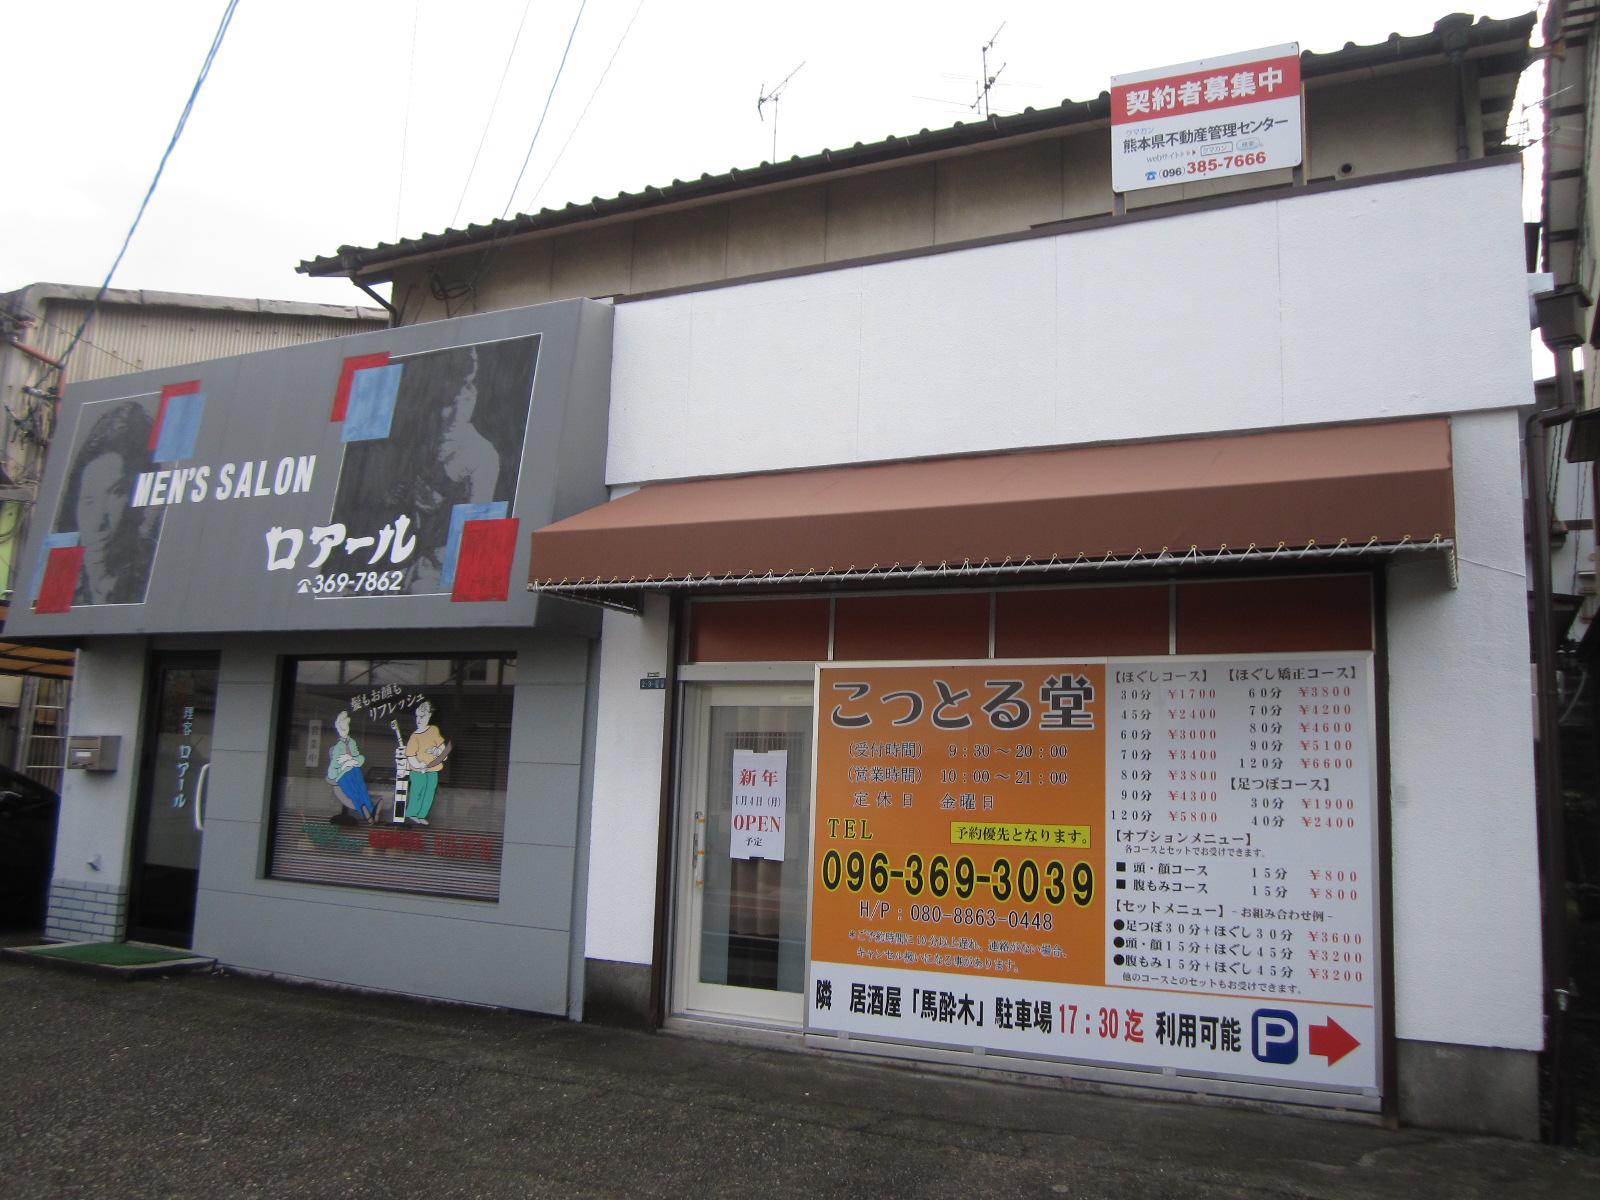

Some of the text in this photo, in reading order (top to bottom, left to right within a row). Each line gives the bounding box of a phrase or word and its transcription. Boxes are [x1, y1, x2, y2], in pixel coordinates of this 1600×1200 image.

[1126, 67, 1283, 116] 契約者募集中
[1123, 116, 1288, 154] 熊本県不動産管理センター
[132, 455, 316, 507] MEN'S SALON
[266, 514, 416, 571] ロアール
[312, 570, 402, 594] 369-7862
[1121, 689, 1151, 701] 30分
[1249, 687, 1282, 698] 60分
[369, 693, 425, 721] リフレッシュ
[831, 672, 1096, 731] こつとる堂
[1121, 708, 1152, 720] 45分
[1250, 705, 1282, 717] 70分
[1120, 729, 1152, 740] 60分
[1250, 723, 1283, 734] 80分
[1121, 749, 1152, 760] 70分
[1250, 740, 1283, 752] 90分
[1239, 758, 1283, 770] 120分
[173, 745, 192, 807] ロアール
[739, 768, 778, 787] 新年
[1121, 769, 1152, 781] 80分
[853, 791, 995, 810] 定休日 金曜日
[1121, 789, 1152, 801] 90分
[1251, 798, 1284, 809] 30分
[734, 814, 781, 833] OPEN
[1111, 809, 1152, 821] 120分
[1251, 816, 1285, 828] 40分
[828, 818, 873, 840] TEL
[957, 826, 1088, 846] 予約優先となります。
[1133, 861, 1208, 876] 頭・顔コース
[822, 848, 1096, 907] 096-369-3039
[1133, 879, 1209, 894] 腹もみコース
[910, 904, 1053, 931] 080-8863-0448
[816, 979, 832, 1011] 隣
[1155, 1010, 1242, 1053] 利用可能
[1257, 1015, 1294, 1057] P
